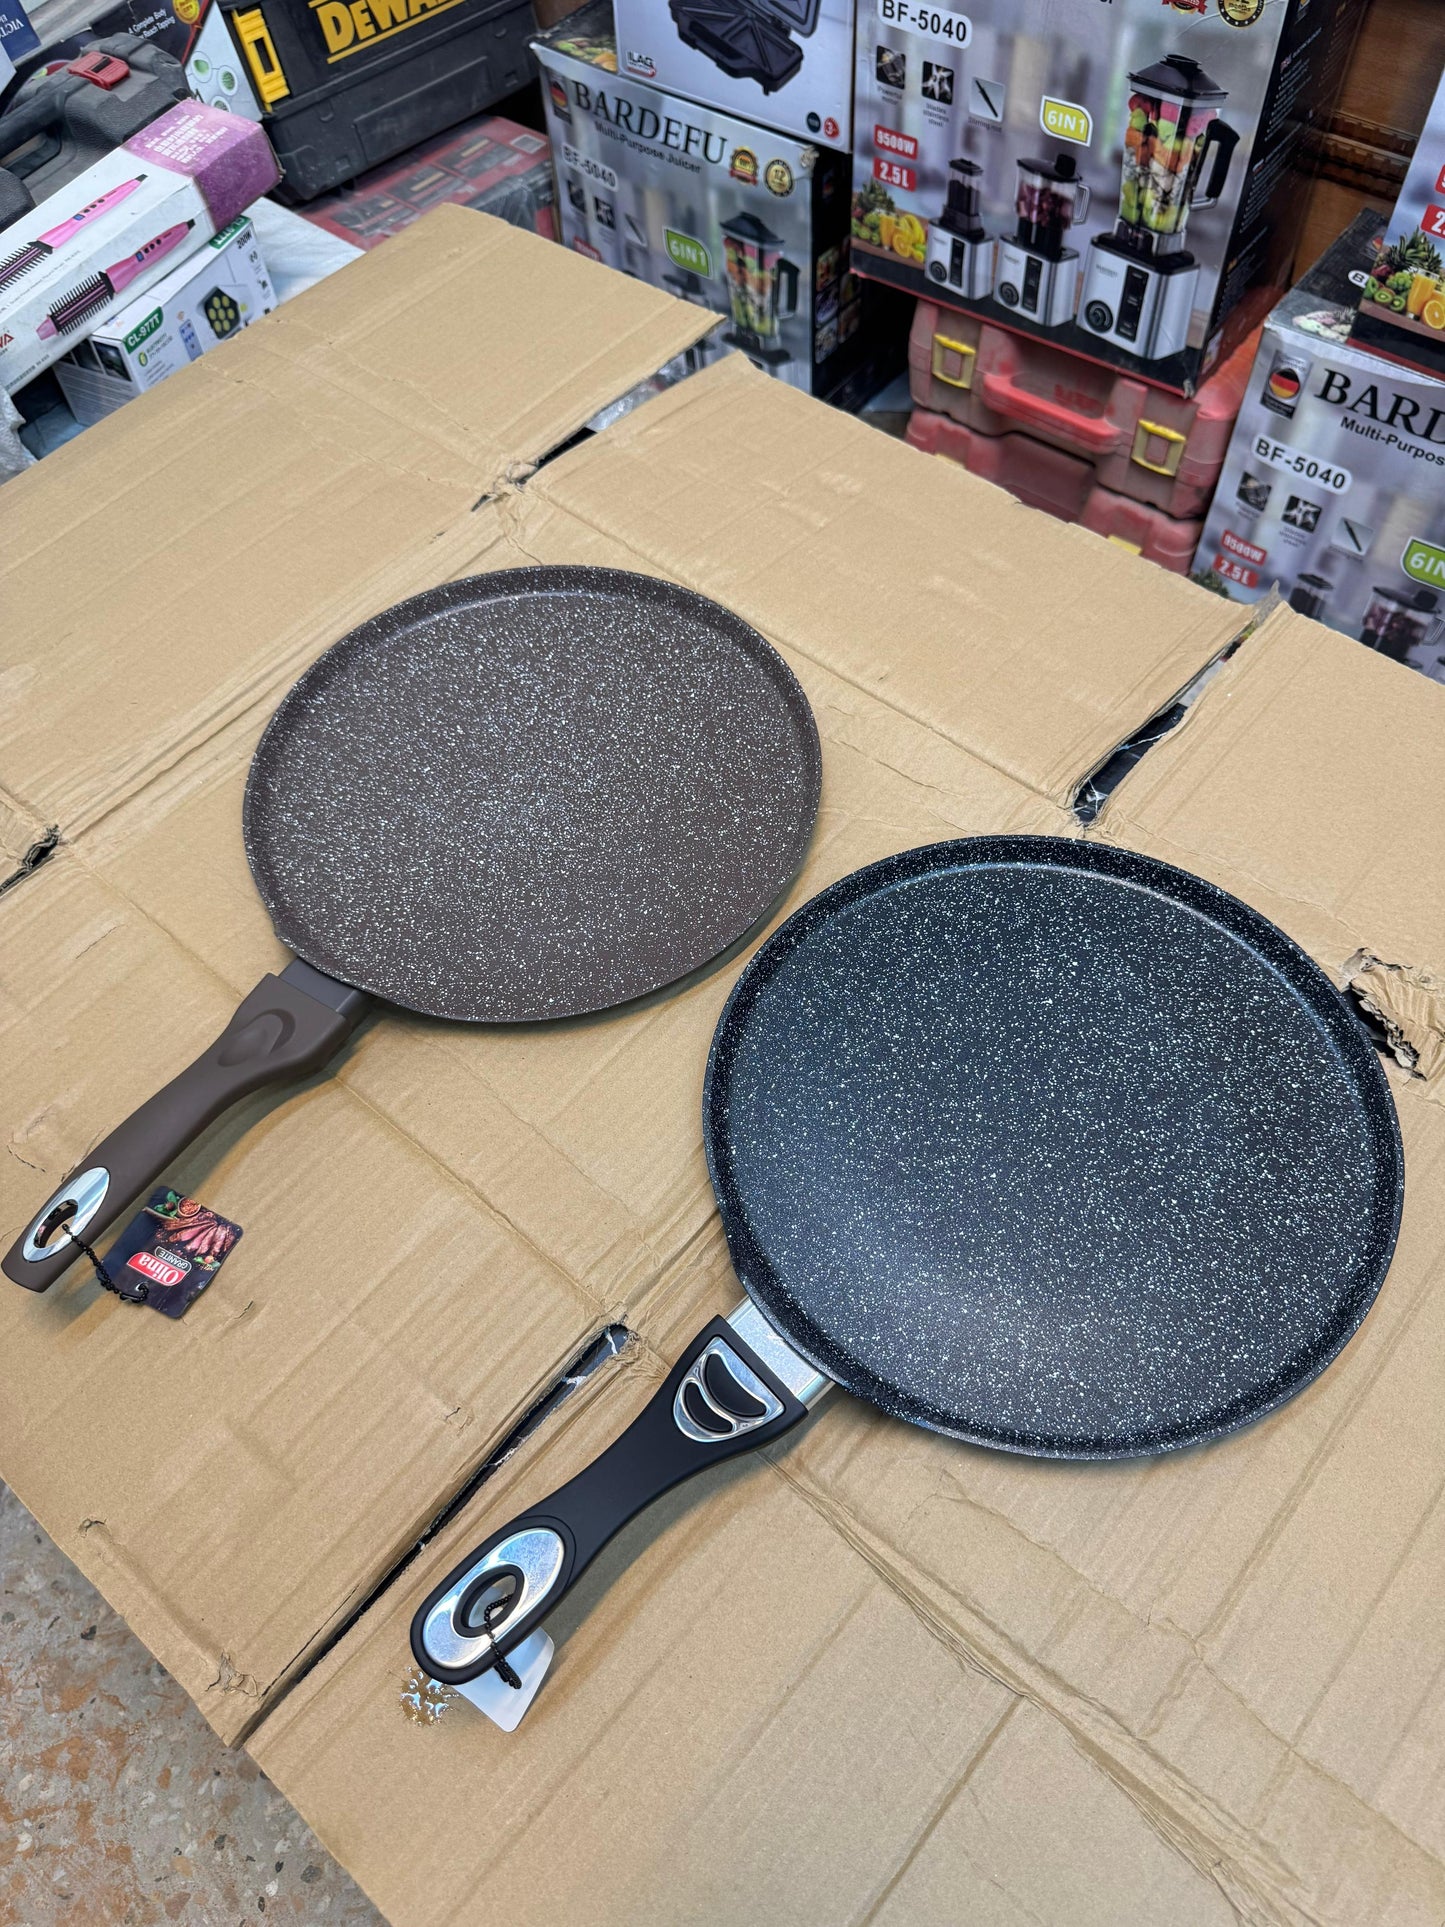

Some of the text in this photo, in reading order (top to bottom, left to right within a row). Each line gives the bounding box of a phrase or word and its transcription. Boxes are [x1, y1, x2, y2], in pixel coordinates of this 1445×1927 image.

[0, 18, 25, 38] VICT
[132, 16, 155, 33] Complete
[882, 0, 967, 42] BF-5040
[571, 80, 728, 165] BARDEFU
[876, 130, 915, 155] 9500W
[880, 162, 909, 188] 2.5L
[128, 313, 162, 347] CL-977T
[1255, 438, 1347, 490] BF-5040
[1218, 559, 1249, 585] 2.5L
[138, 1255, 180, 1284] Olina
[160, 1251, 188, 1270] GRANITE
